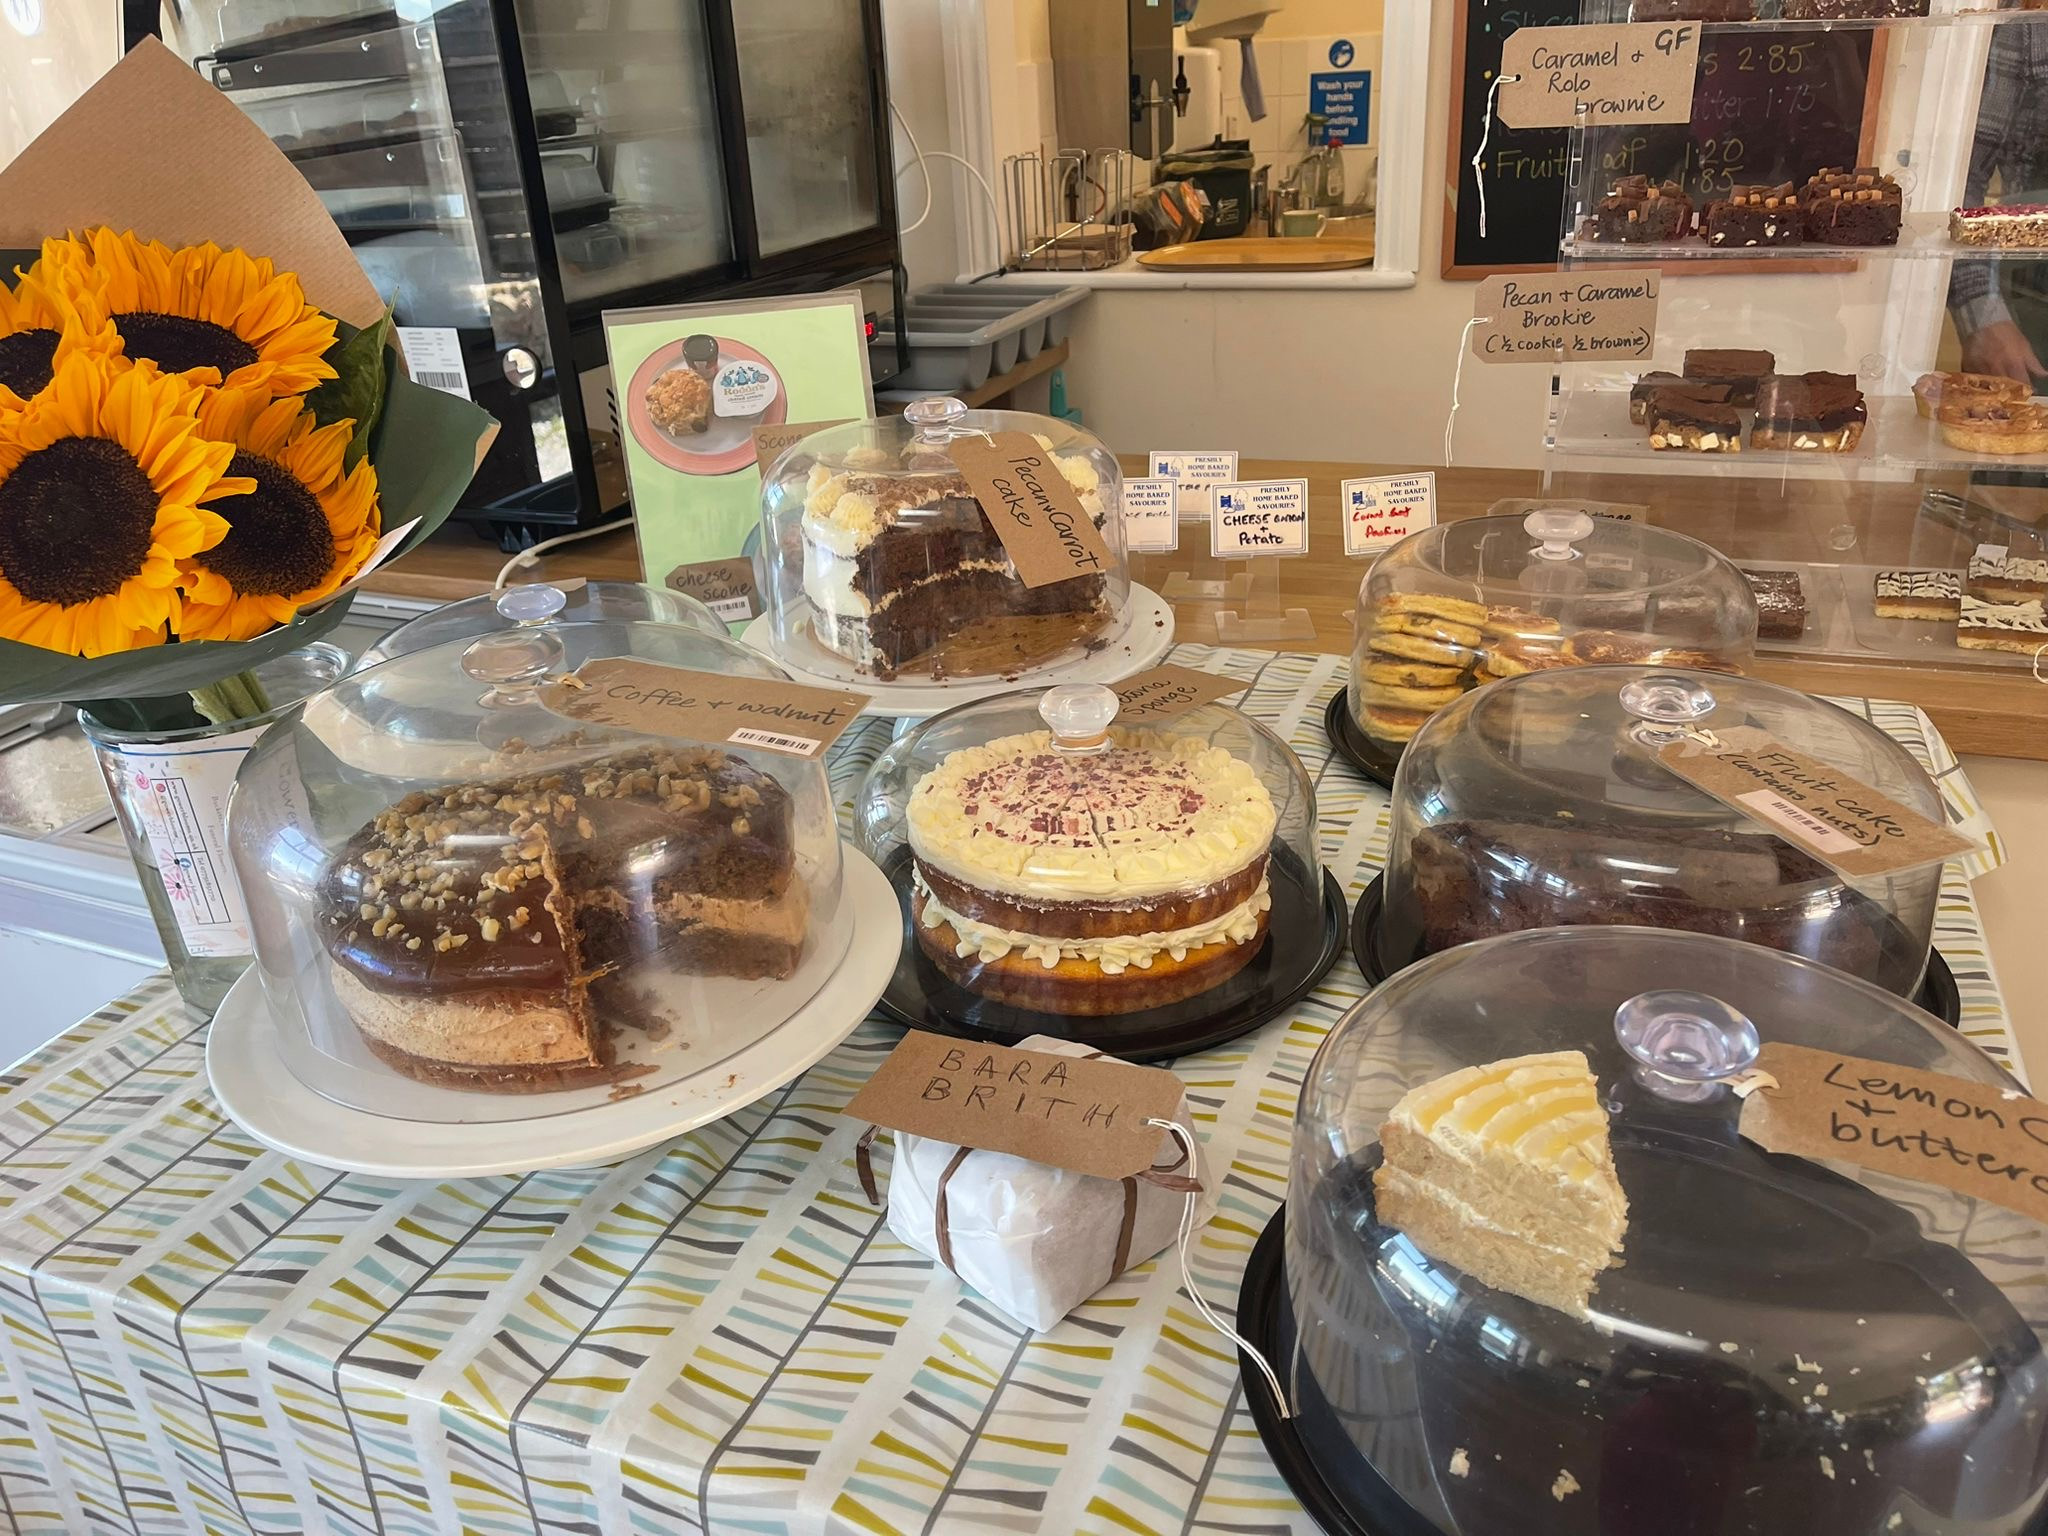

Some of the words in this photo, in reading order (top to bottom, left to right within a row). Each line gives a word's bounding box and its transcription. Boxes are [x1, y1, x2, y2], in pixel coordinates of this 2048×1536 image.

[1655, 26, 1692, 54] GF
[1532, 42, 1618, 70] Caramel
[1548, 72, 1591, 94] Rolo
[1575, 91, 1665, 116] brownie
[1496, 147, 1567, 179] Fruit
[1603, 137, 1647, 174] oaf
[1503, 282, 1552, 308] Pecan
[1577, 279, 1657, 302] Caramel
[1522, 308, 1596, 328] Brookie
[1517, 333, 1565, 351] cookie
[1384, 489, 1403, 497] HOME
[1404, 487, 1427, 495] BAKED
[1390, 480, 1419, 488] FRESHLY
[1008, 456, 1050, 506] Pecan
[1048, 511, 1099, 568] Carrot
[1388, 496, 1424, 504] SAVOURIES
[1223, 513, 1271, 526] CHEESE
[1239, 531, 1284, 546] Potato
[703, 582, 752, 600] scone
[607, 685, 696, 709] Coffee
[737, 701, 846, 726] walnut
[1757, 752, 1840, 793] Fruit
[1811, 805, 1881, 846] nuts)
[939, 1048, 1073, 1088] BARA
[921, 1075, 1120, 1128] BRITH
[1824, 1063, 2005, 1128] Lemon
